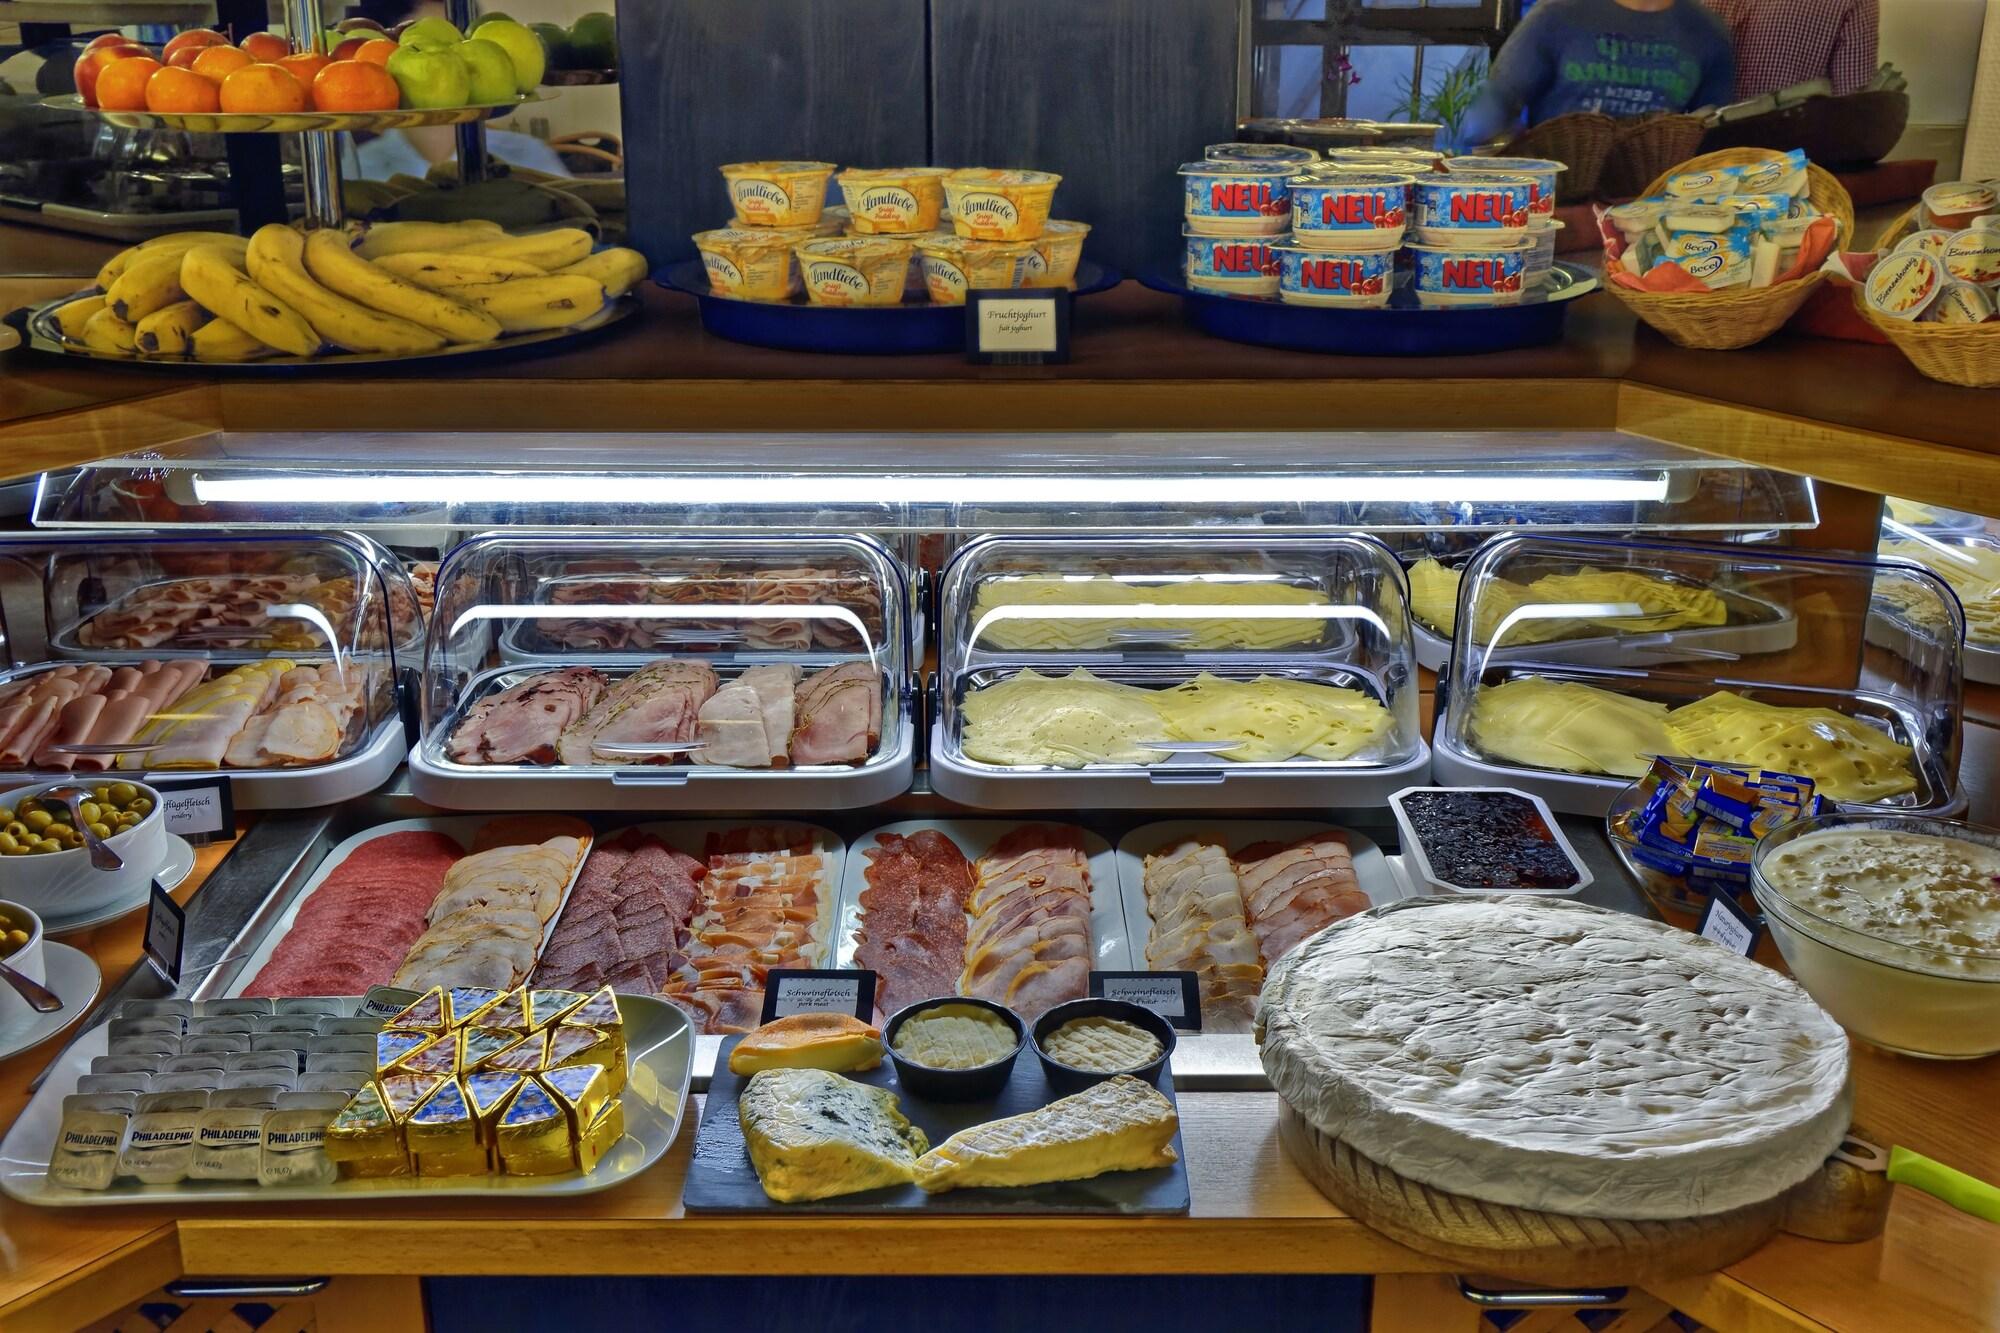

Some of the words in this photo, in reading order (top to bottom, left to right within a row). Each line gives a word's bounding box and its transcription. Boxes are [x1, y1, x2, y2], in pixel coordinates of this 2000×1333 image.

[863, 191, 914, 212] Landliebe
[1211, 181, 1272, 212] NEU
[1450, 191, 1515, 223] NEU
[961, 198, 1013, 220] Landliebe
[1322, 193, 1386, 225] NEU
[1212, 243, 1274, 273] NEU
[1684, 242, 1712, 253] Becel
[1301, 260, 1364, 290] NEU
[1442, 258, 1505, 288] NEU
[1690, 260, 1718, 274] Becel
[1875, 256, 1919, 305] Bienenhonig
[986, 308, 1048, 323] Fruchtjoghurt
[786, 987, 851, 1000] Schweinefleisch
[1111, 986, 1177, 1000] Schweinefleisch
[64, 1131, 119, 1145] PHILADELPHIA
[200, 1127, 261, 1140] PHILADELPHI
